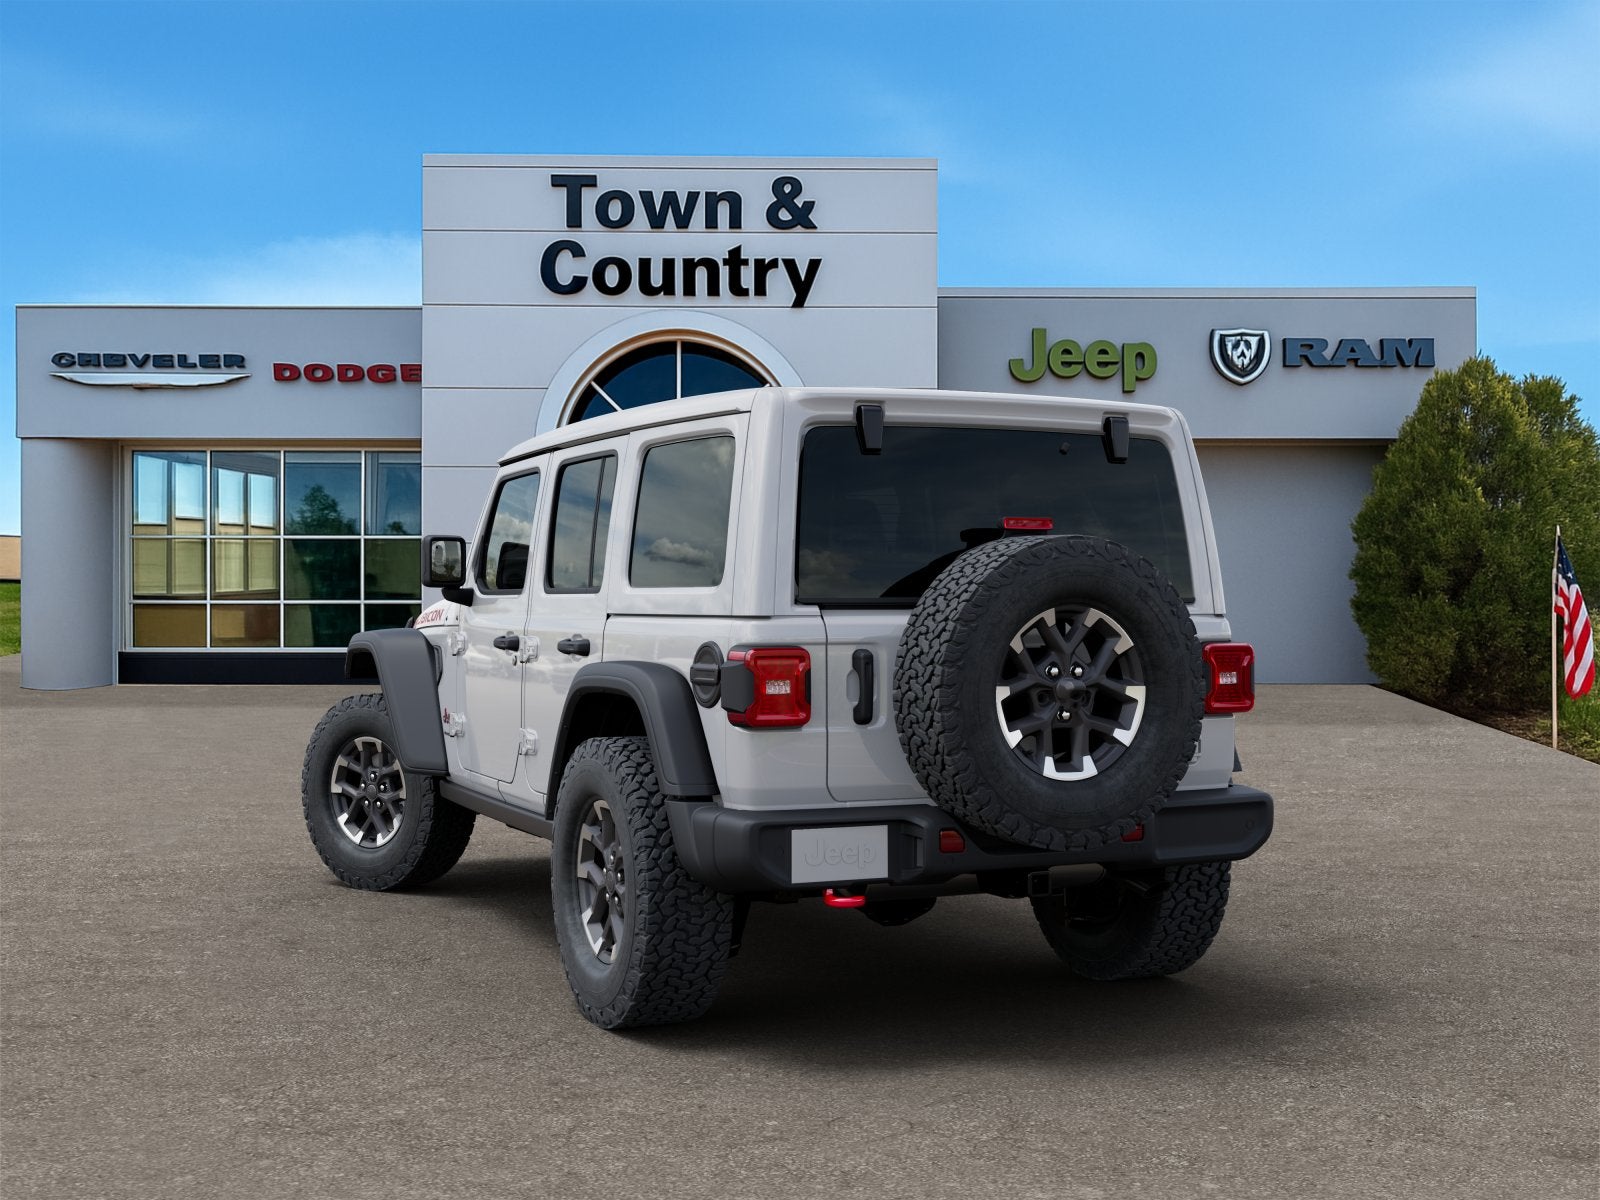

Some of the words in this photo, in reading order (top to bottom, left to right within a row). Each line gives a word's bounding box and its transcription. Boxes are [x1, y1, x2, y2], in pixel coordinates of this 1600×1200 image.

[550, 174, 743, 229] Town
[765, 175, 818, 230] &
[540, 239, 823, 308] Country
[272, 362, 423, 384] DODGE
[1009, 327, 1158, 393] Jeep
[1282, 337, 1436, 368] RAM
[804, 838, 877, 873] Jeep
